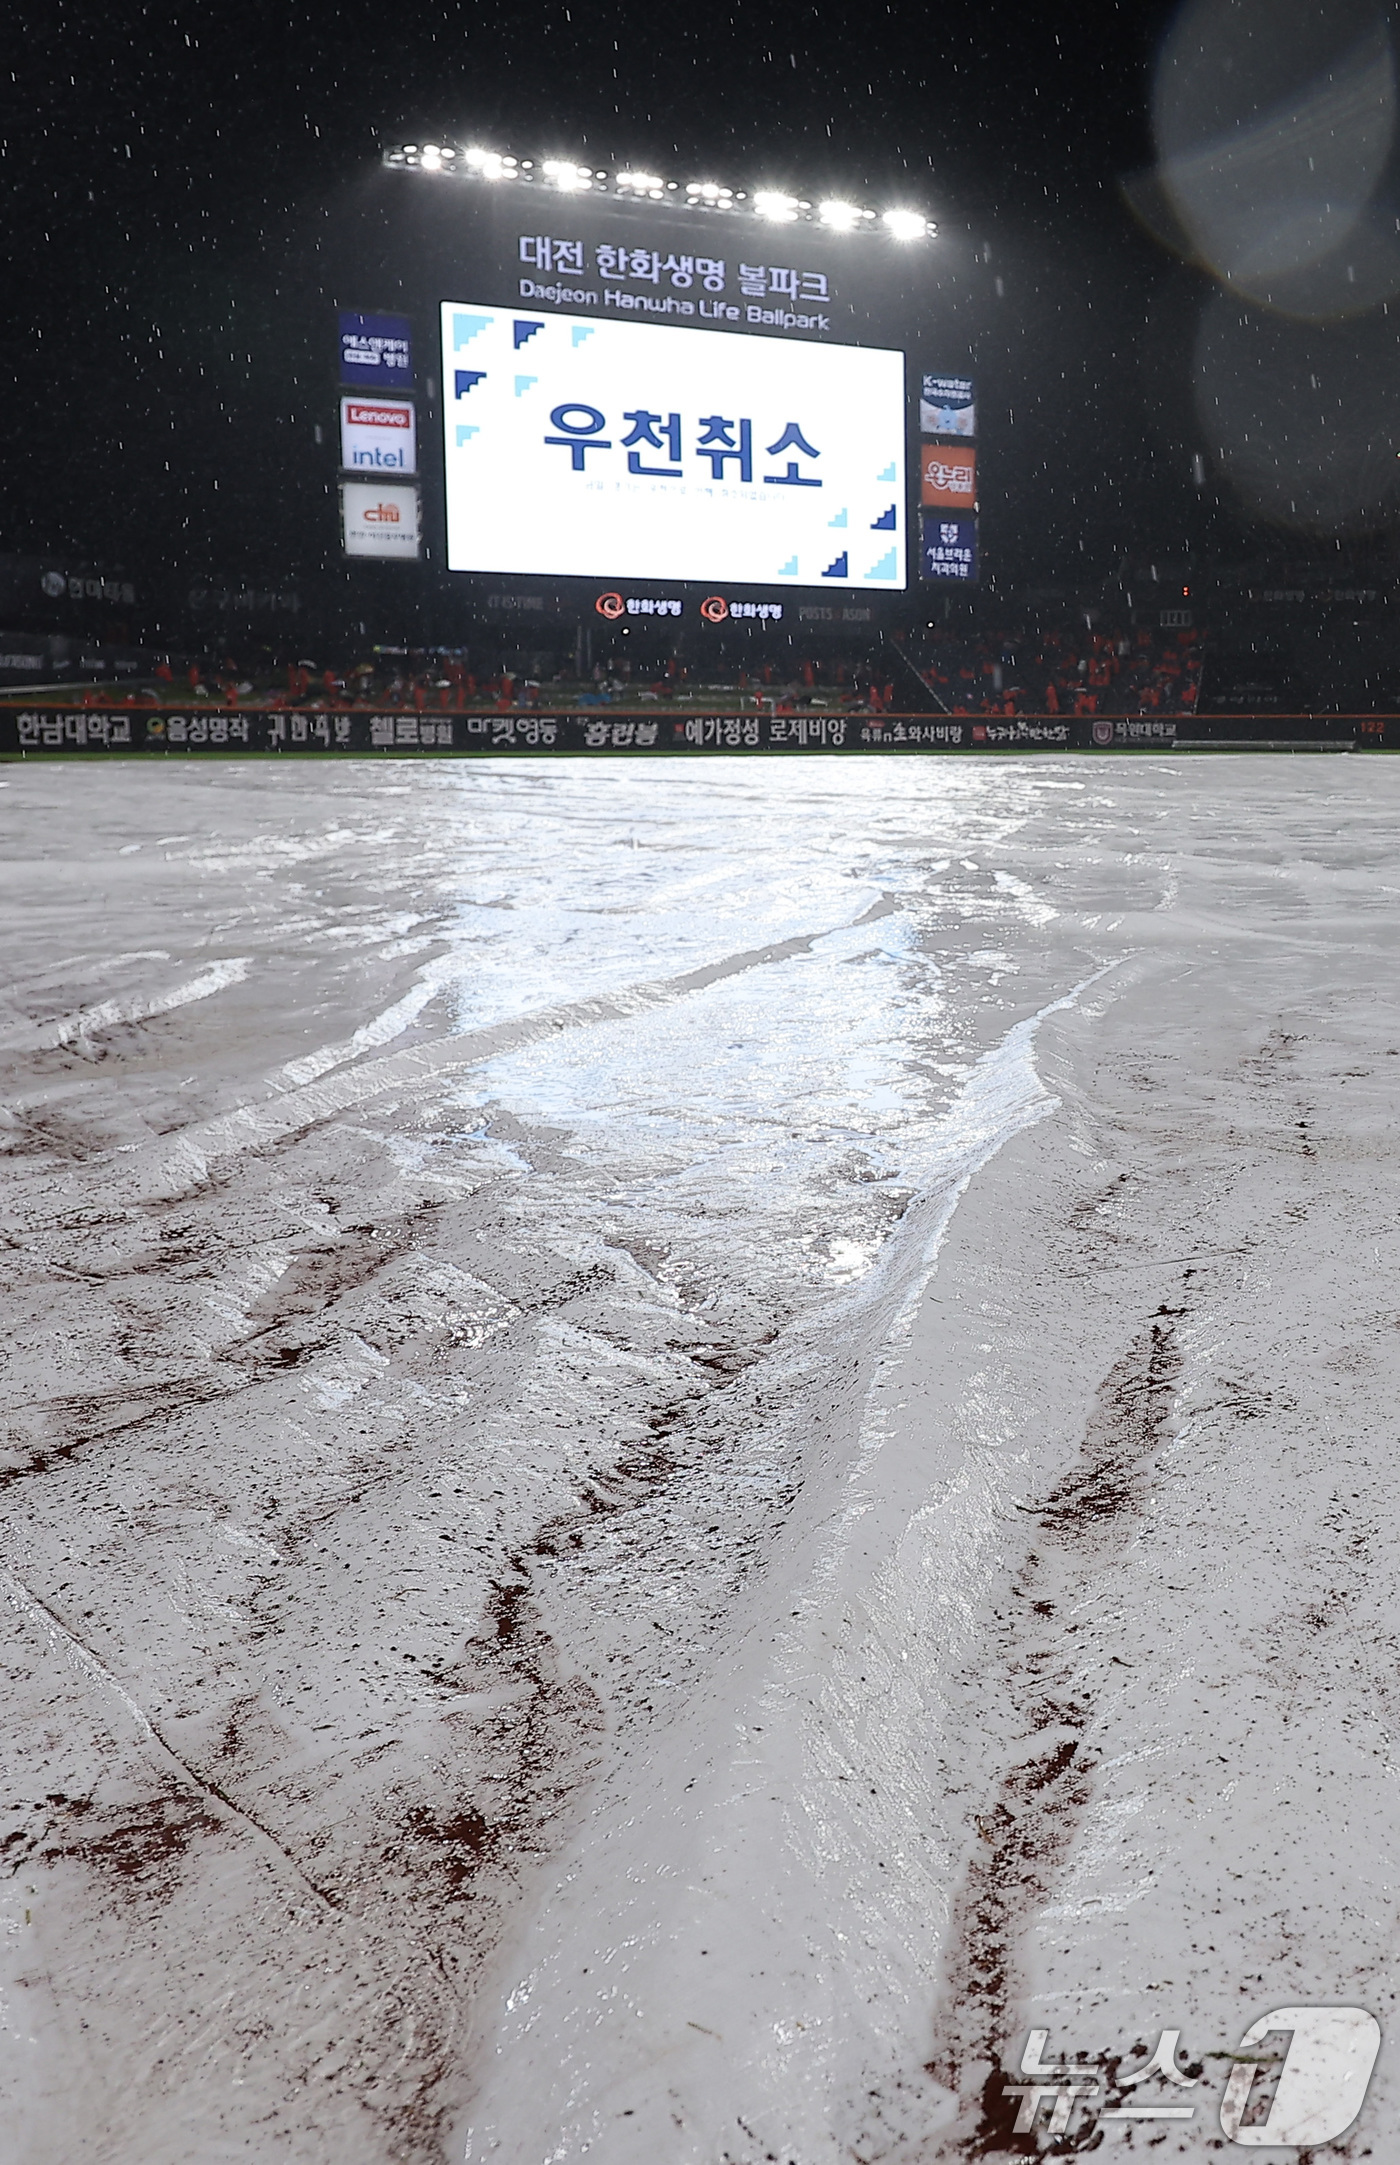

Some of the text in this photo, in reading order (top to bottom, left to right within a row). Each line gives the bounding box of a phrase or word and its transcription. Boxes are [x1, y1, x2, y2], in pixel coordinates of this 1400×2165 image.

[518, 235, 831, 304] 대전 한화생명 볼파크
[519, 279, 831, 332] Daejeon Hanwha Life Ballpark
[922, 374, 972, 391] K-water
[351, 407, 406, 425] Lenovo
[543, 402, 823, 488] 우천취소
[353, 446, 404, 468] intel
[931, 562, 969, 577] 치과의원
[626, 597, 682, 617] 한화생명
[729, 601, 783, 620] 한화생명
[16, 712, 132, 745] 한남대학교
[166, 715, 250, 743] 음성명작
[466, 717, 559, 745] 마켓영동
[684, 717, 848, 746] 예가정성 로제비앙
[1115, 722, 1177, 737] 목원대학교
[1360, 721, 1385, 733] 122
